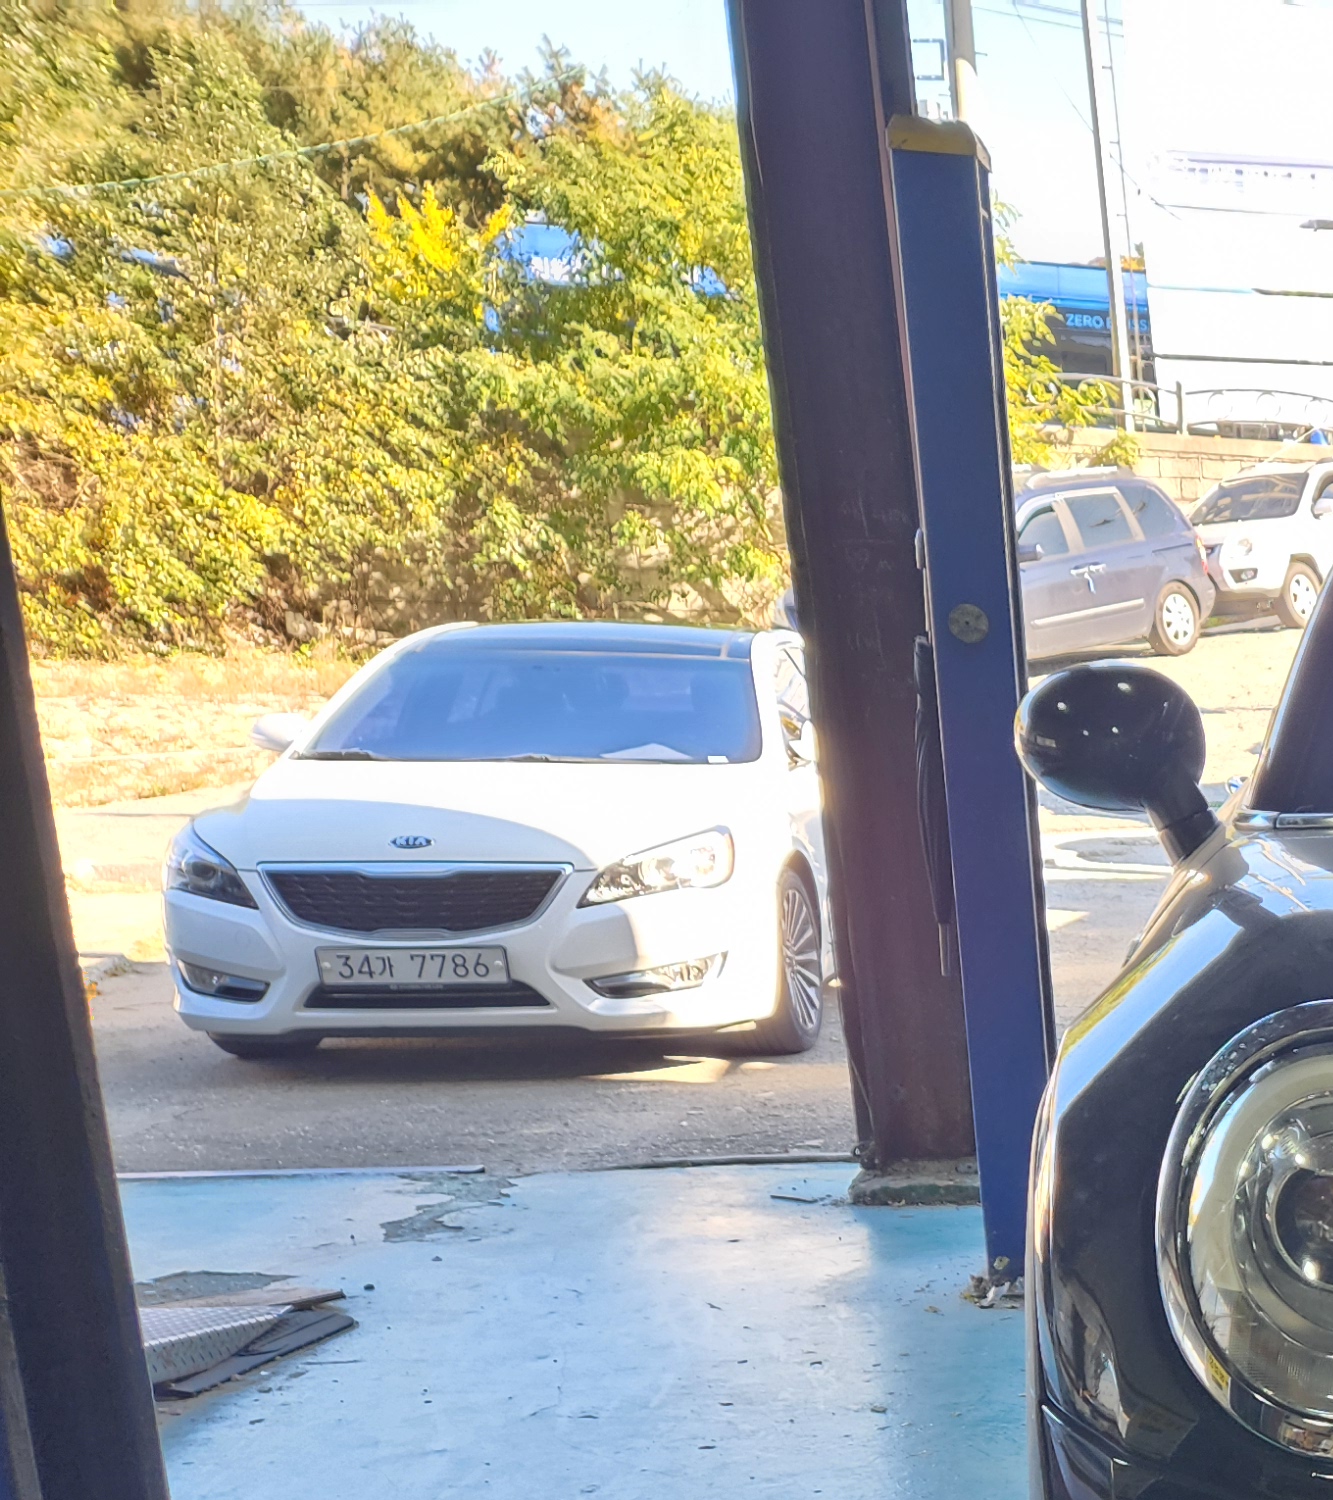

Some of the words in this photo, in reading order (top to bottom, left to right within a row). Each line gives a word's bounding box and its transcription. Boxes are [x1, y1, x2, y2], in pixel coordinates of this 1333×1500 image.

[1065, 313, 1105, 329] ZERO
[395, 836, 427, 846] KIA
[336, 953, 394, 979] 34가
[409, 952, 490, 978] 7786
